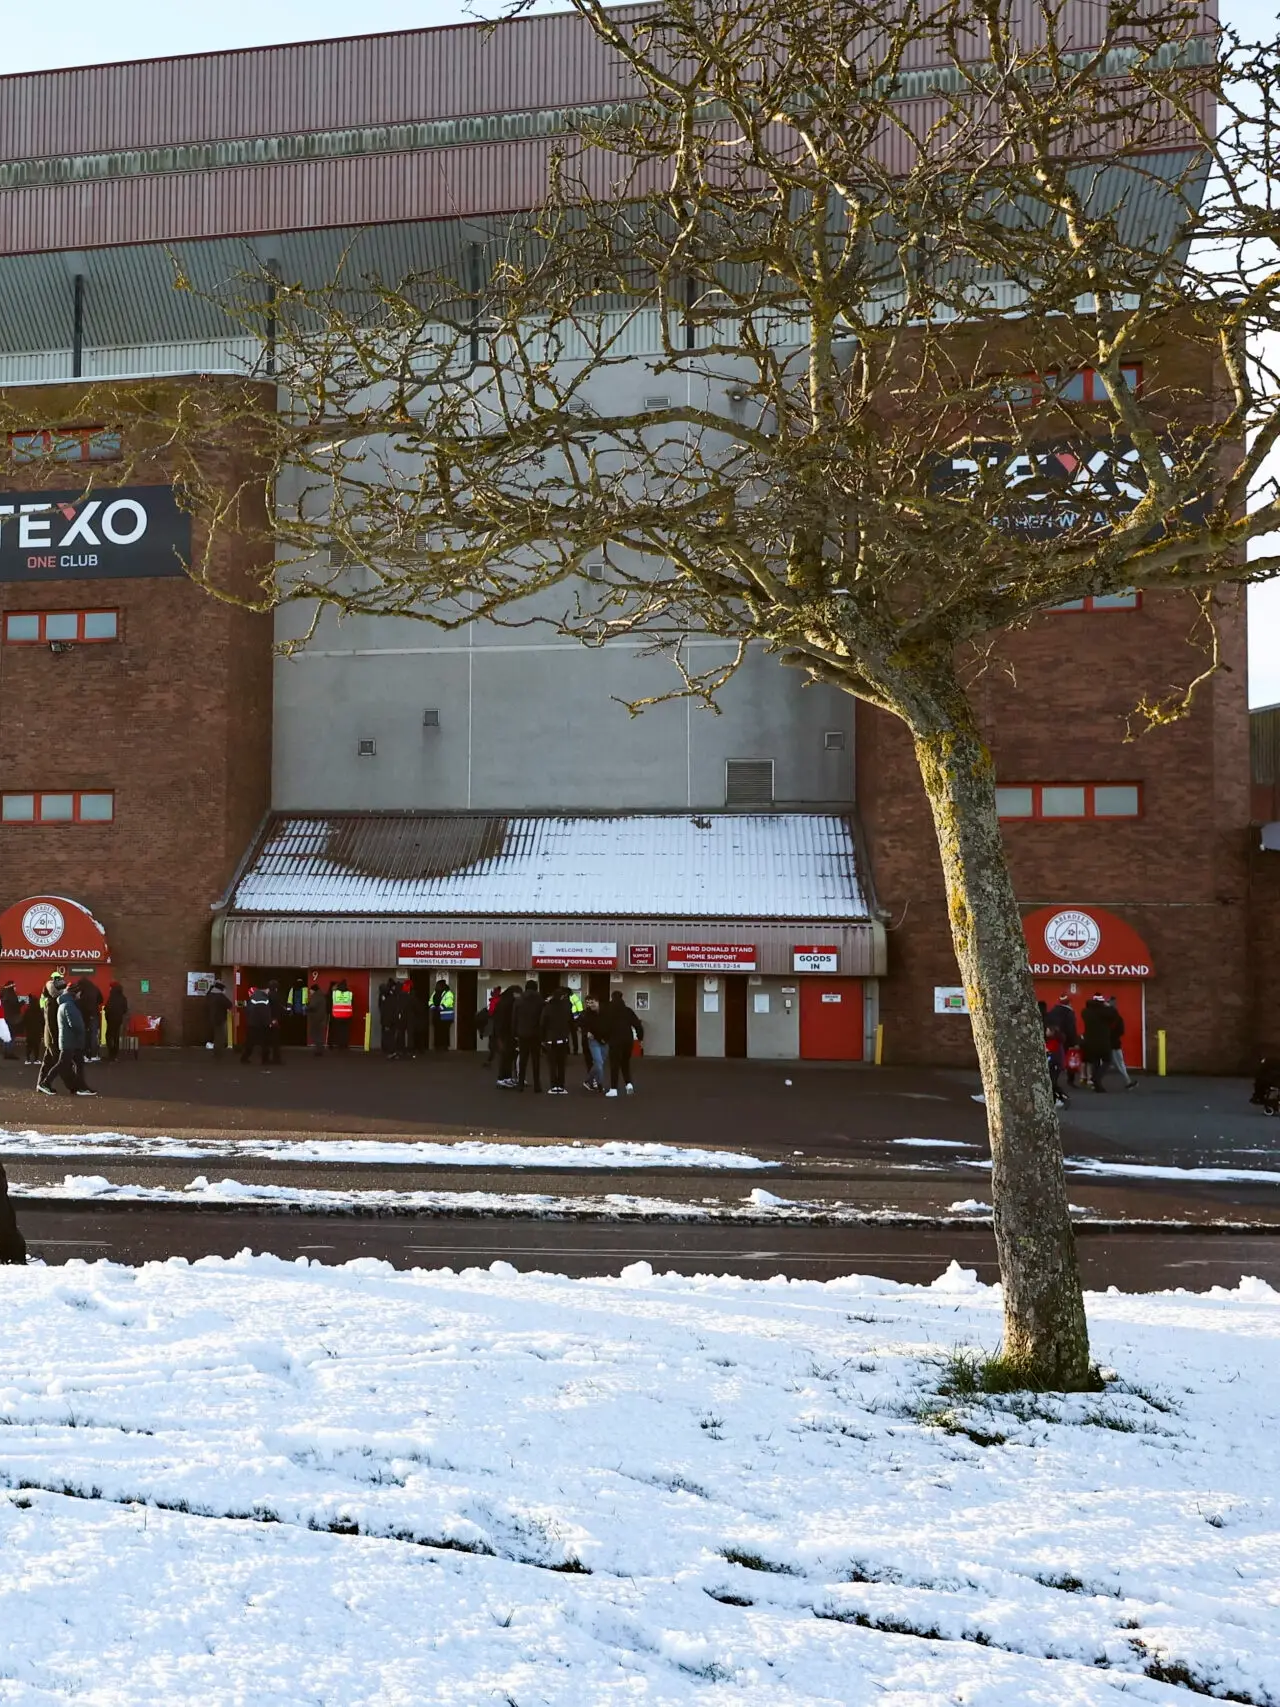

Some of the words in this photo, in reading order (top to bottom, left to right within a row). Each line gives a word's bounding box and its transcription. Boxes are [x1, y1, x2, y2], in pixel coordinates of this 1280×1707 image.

[27, 556, 57, 569] ONE
[60, 554, 98, 568] CLUB
[1054, 914, 1091, 926] ABERDEEN
[1048, 936, 1081, 958] FOOTBALL
[28, 948, 69, 959] DONALD
[70, 949, 101, 959] STAND
[799, 955, 832, 963] GOODS
[810, 963, 821, 971] IN
[1053, 963, 1106, 975] DONALD
[1108, 964, 1150, 976] STAND
[311, 970, 319, 982] 9
[1070, 982, 1077, 994] 8
